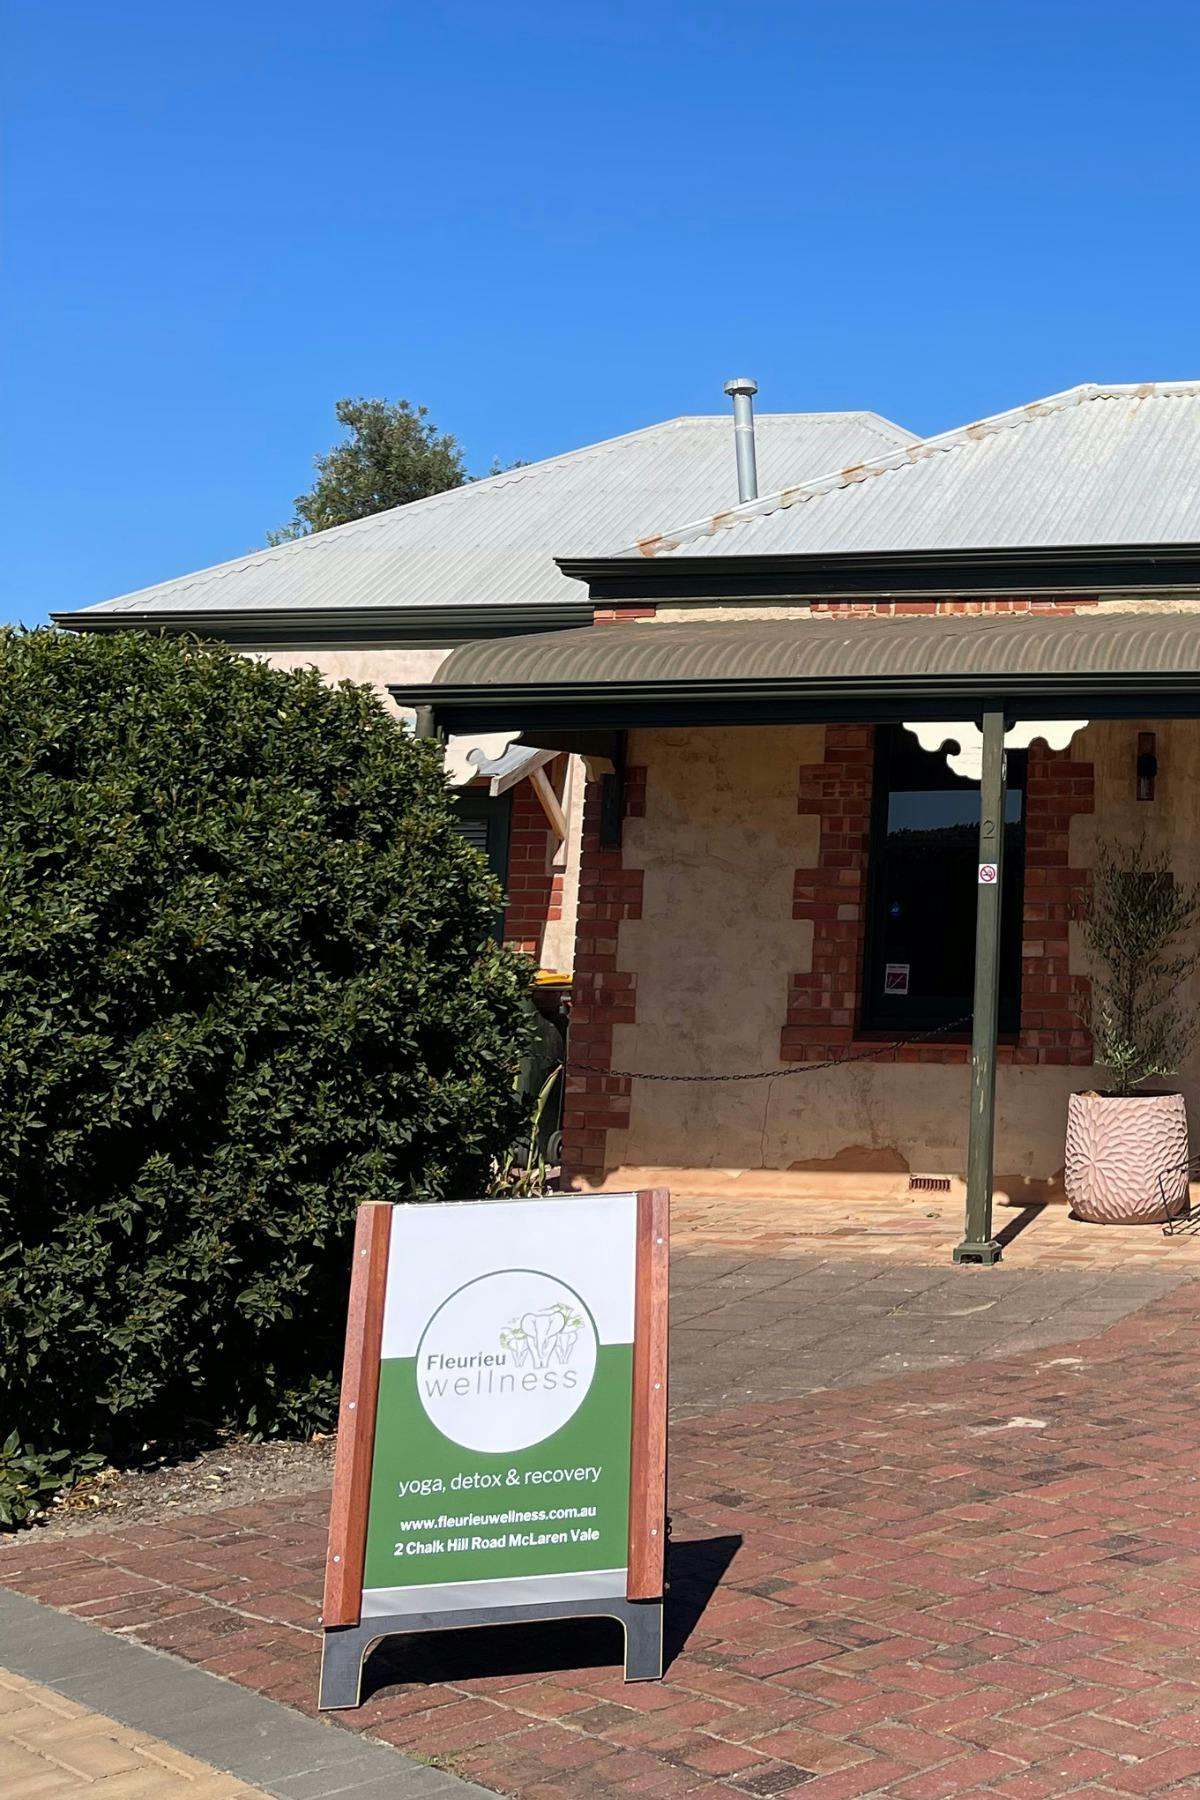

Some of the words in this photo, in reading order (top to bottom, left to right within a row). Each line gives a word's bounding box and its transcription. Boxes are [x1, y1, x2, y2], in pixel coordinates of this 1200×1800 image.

[982, 819, 995, 839] 2
[426, 1352, 506, 1370] Fleurieu
[425, 1370, 578, 1398] wellness
[398, 1478, 446, 1497] yoga,
[450, 1472, 502, 1490] detox
[505, 1468, 520, 1486] &
[524, 1466, 602, 1485] recovery
[400, 1506, 597, 1531] www.fleurieuwellness.com.au
[393, 1542, 404, 1556] 2
[405, 1540, 445, 1555] Chalk
[447, 1537, 469, 1552] Hill
[471, 1534, 506, 1550] Road
[508, 1532, 568, 1547] McLaren
[570, 1528, 600, 1542] Vale
